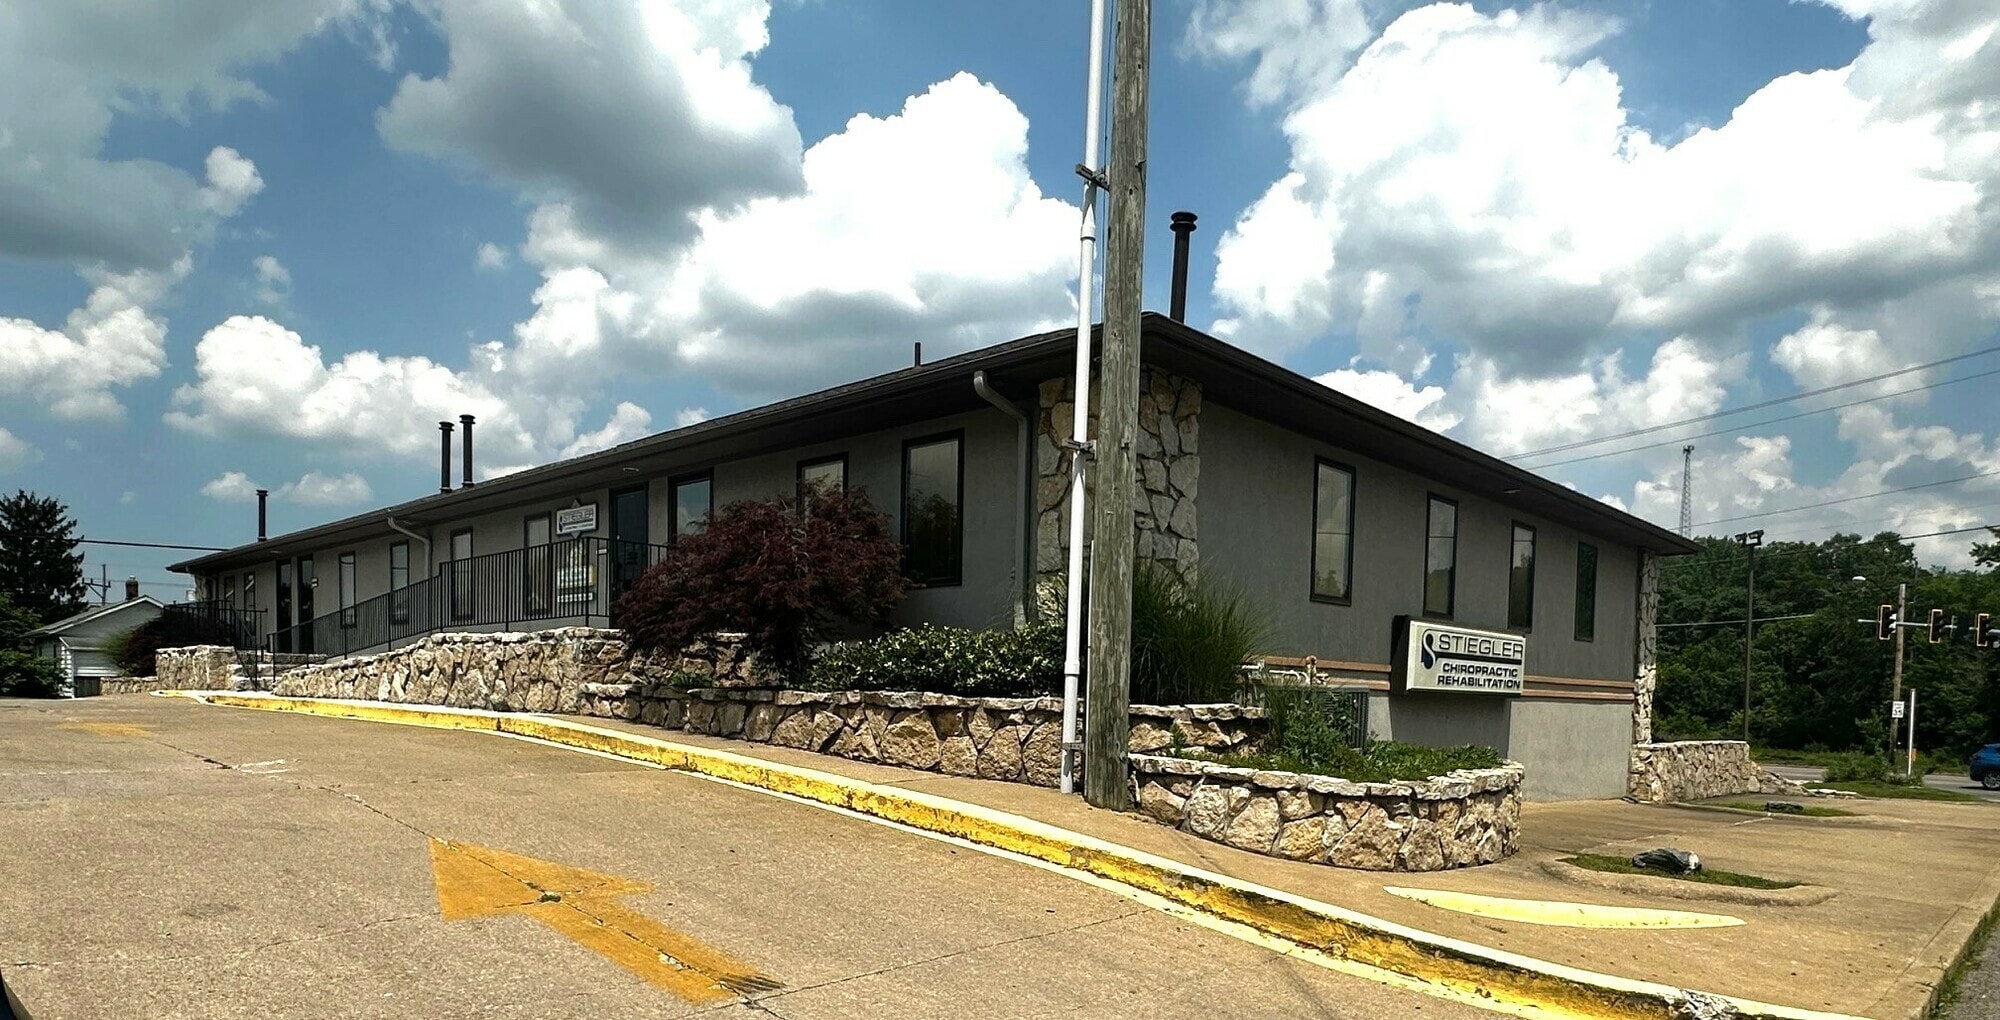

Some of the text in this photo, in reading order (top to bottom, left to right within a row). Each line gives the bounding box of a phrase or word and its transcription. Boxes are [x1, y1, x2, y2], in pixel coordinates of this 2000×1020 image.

[1439, 634, 1523, 658] STIEGLER
[1442, 663, 1518, 677] CHIROPRACTIC
[1437, 675, 1520, 689] REHABILITATION
